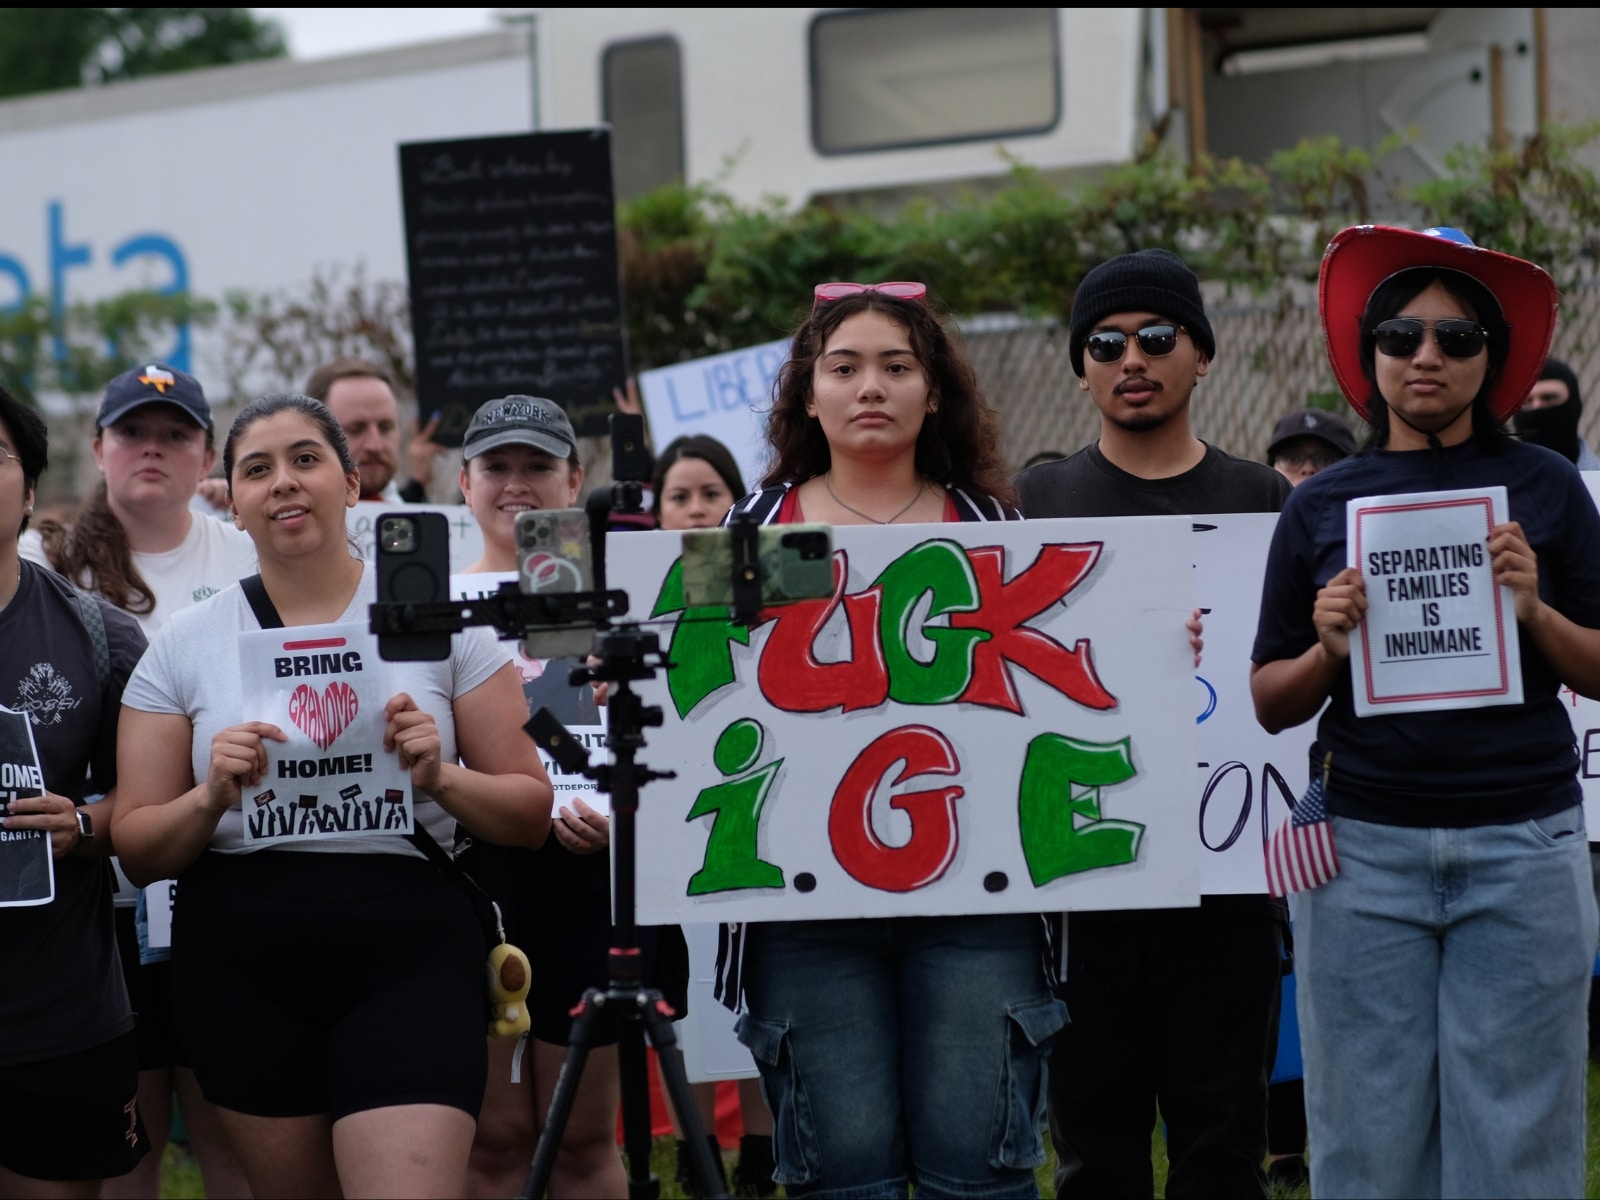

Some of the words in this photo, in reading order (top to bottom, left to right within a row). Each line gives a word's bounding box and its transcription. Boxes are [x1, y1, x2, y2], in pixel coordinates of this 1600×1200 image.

[516, 403, 551, 424] YORK
[1369, 543, 1483, 576] SEPARATING
[1387, 572, 1470, 602] FAMILIES
[1421, 602, 1441, 627] IS
[1385, 627, 1482, 658] INHUMANE
[274, 651, 363, 678] BRING
[288, 681, 359, 752] GRANDMA
[277, 753, 373, 779] HOME!
[0, 831, 41, 842] GARITA
